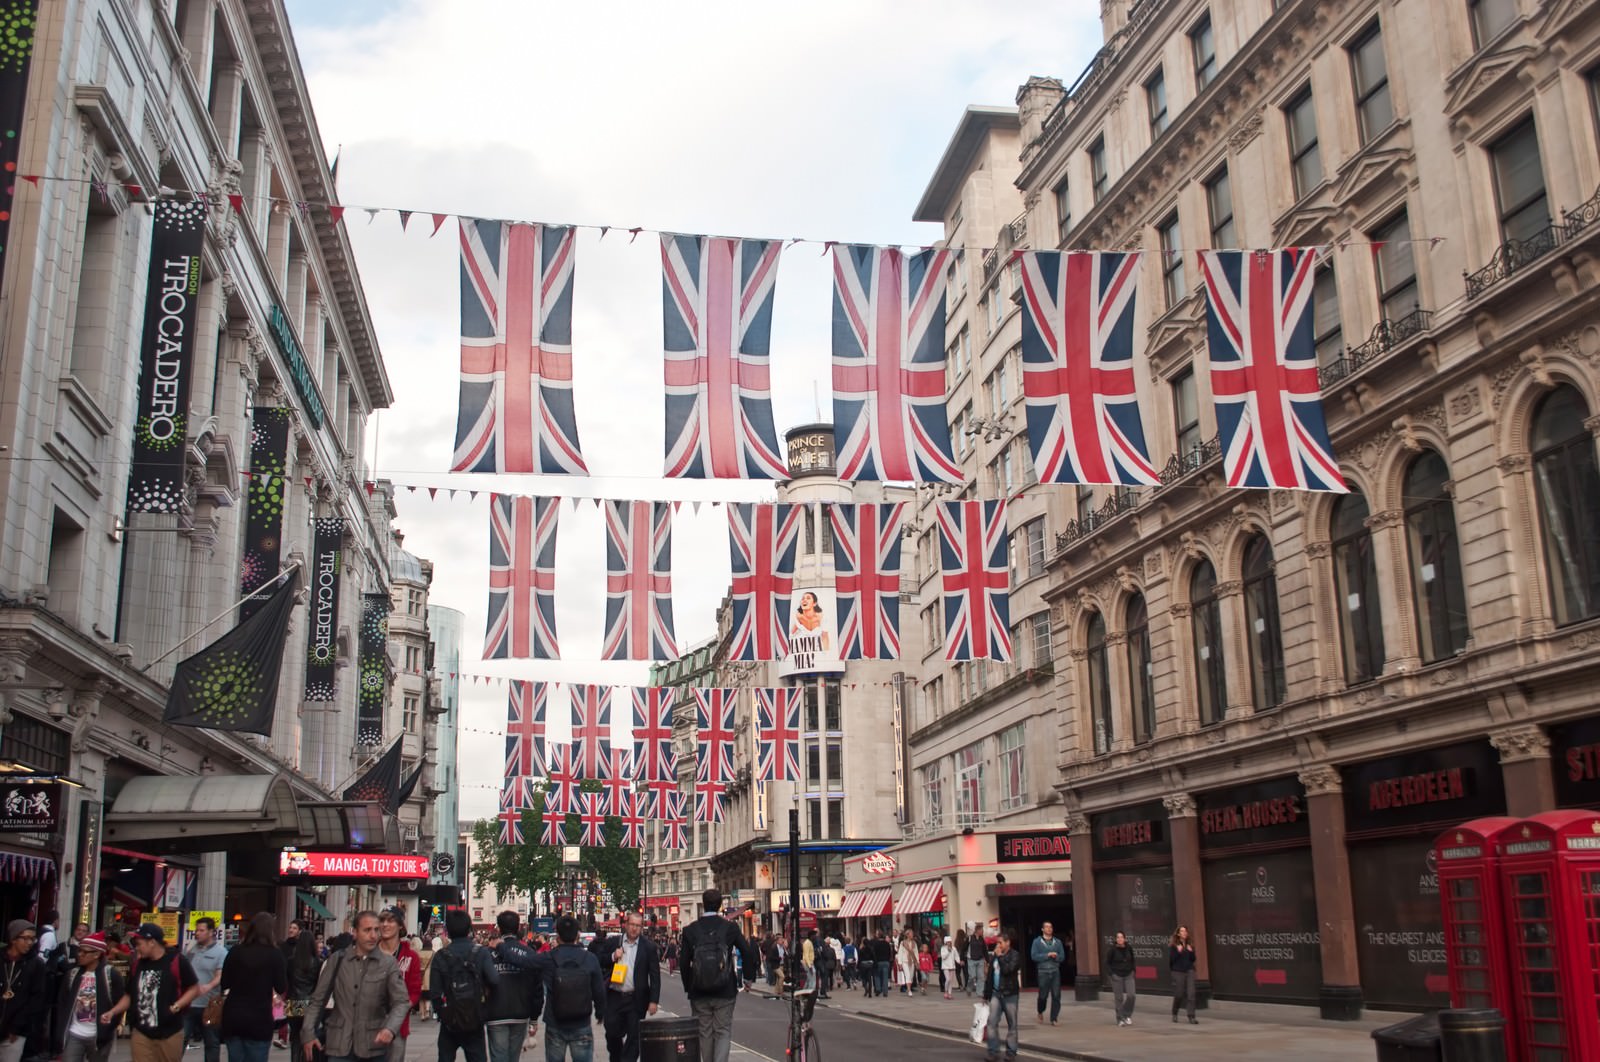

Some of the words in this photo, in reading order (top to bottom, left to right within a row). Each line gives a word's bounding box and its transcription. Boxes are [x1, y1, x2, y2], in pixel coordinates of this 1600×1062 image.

[188, 255, 200, 295] LONDON
[149, 255, 190, 441] TROCADERO
[788, 435, 825, 451] PRINCE
[789, 452, 825, 467] WALES
[316, 550, 336, 660] TROCADERO
[788, 636, 822, 654] MAMMA
[794, 653, 815, 670] MIA!
[1369, 767, 1464, 810] ABERDEEN
[1243, 795, 1297, 830] HOUSES
[324, 857, 368, 873] MANGA
[372, 858, 391, 873] TOY
[393, 859, 417, 874] STORE
[1131, 894, 1149, 905] ANGUS
[1251, 886, 1275, 897] ANGUS
[808, 894, 830, 908] MIA!
[1215, 934, 1228, 945] THE
[1229, 933, 1255, 945] NEAREST
[1256, 933, 1279, 944] ANGUS
[1368, 932, 1384, 945] THE
[1385, 932, 1424, 945] NEAREST
[1408, 950, 1416, 962] IS
